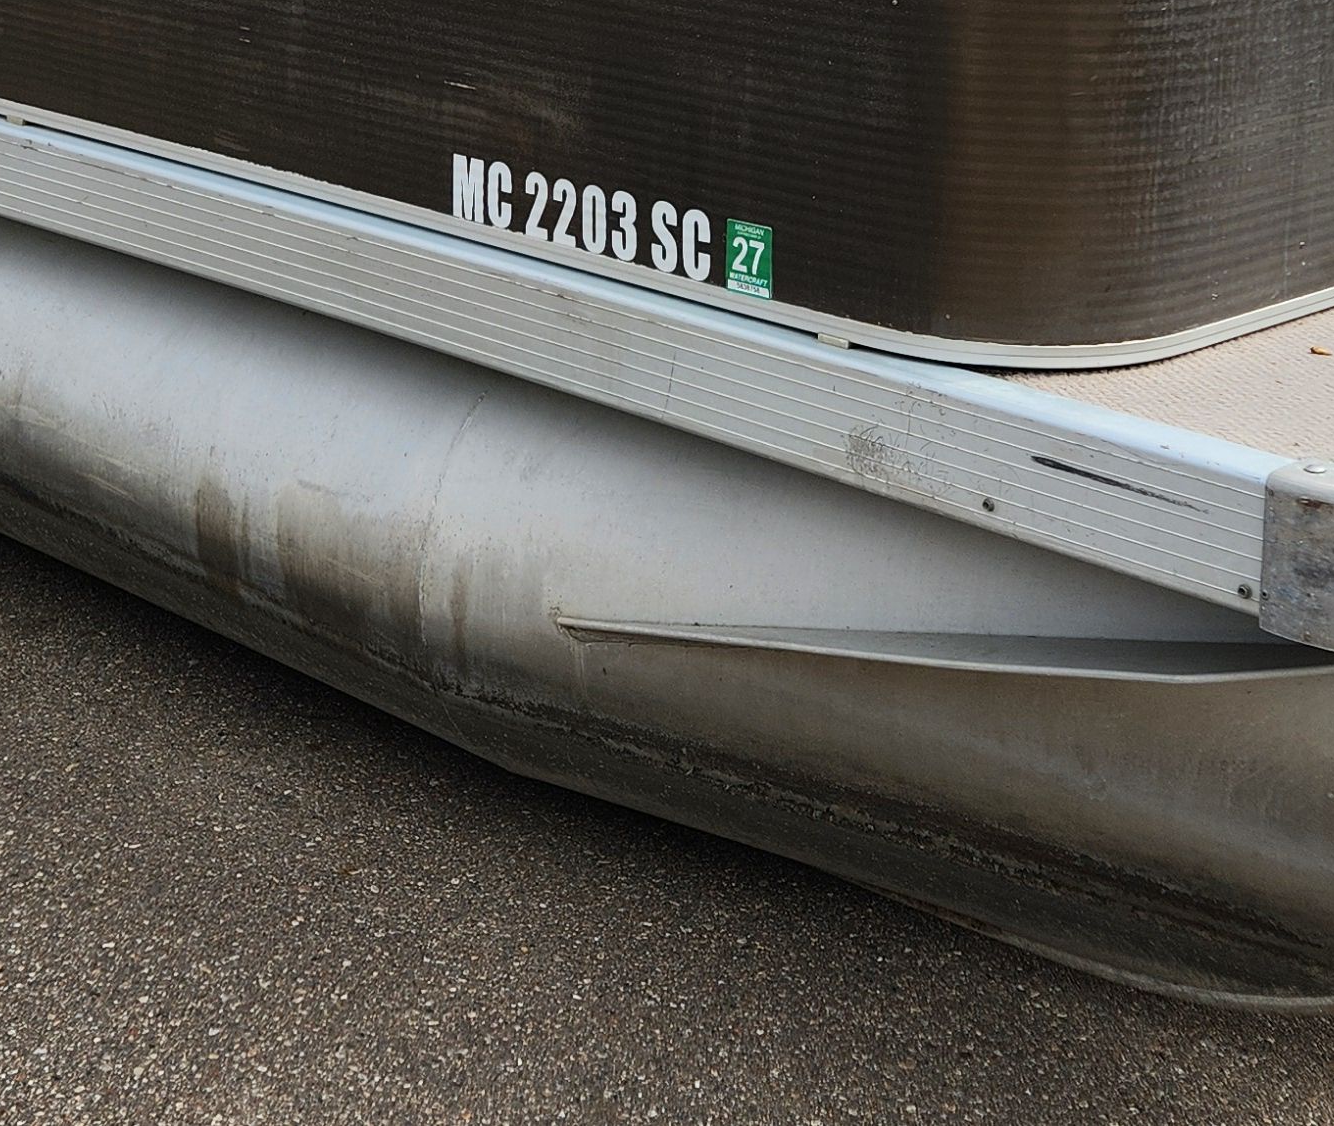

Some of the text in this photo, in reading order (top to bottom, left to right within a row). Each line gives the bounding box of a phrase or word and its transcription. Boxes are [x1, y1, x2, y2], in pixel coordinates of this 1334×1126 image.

[452, 153, 711, 281] MC 2203 SC
[732, 236, 765, 276] 27
[730, 272, 768, 287] WATERCRAFT
